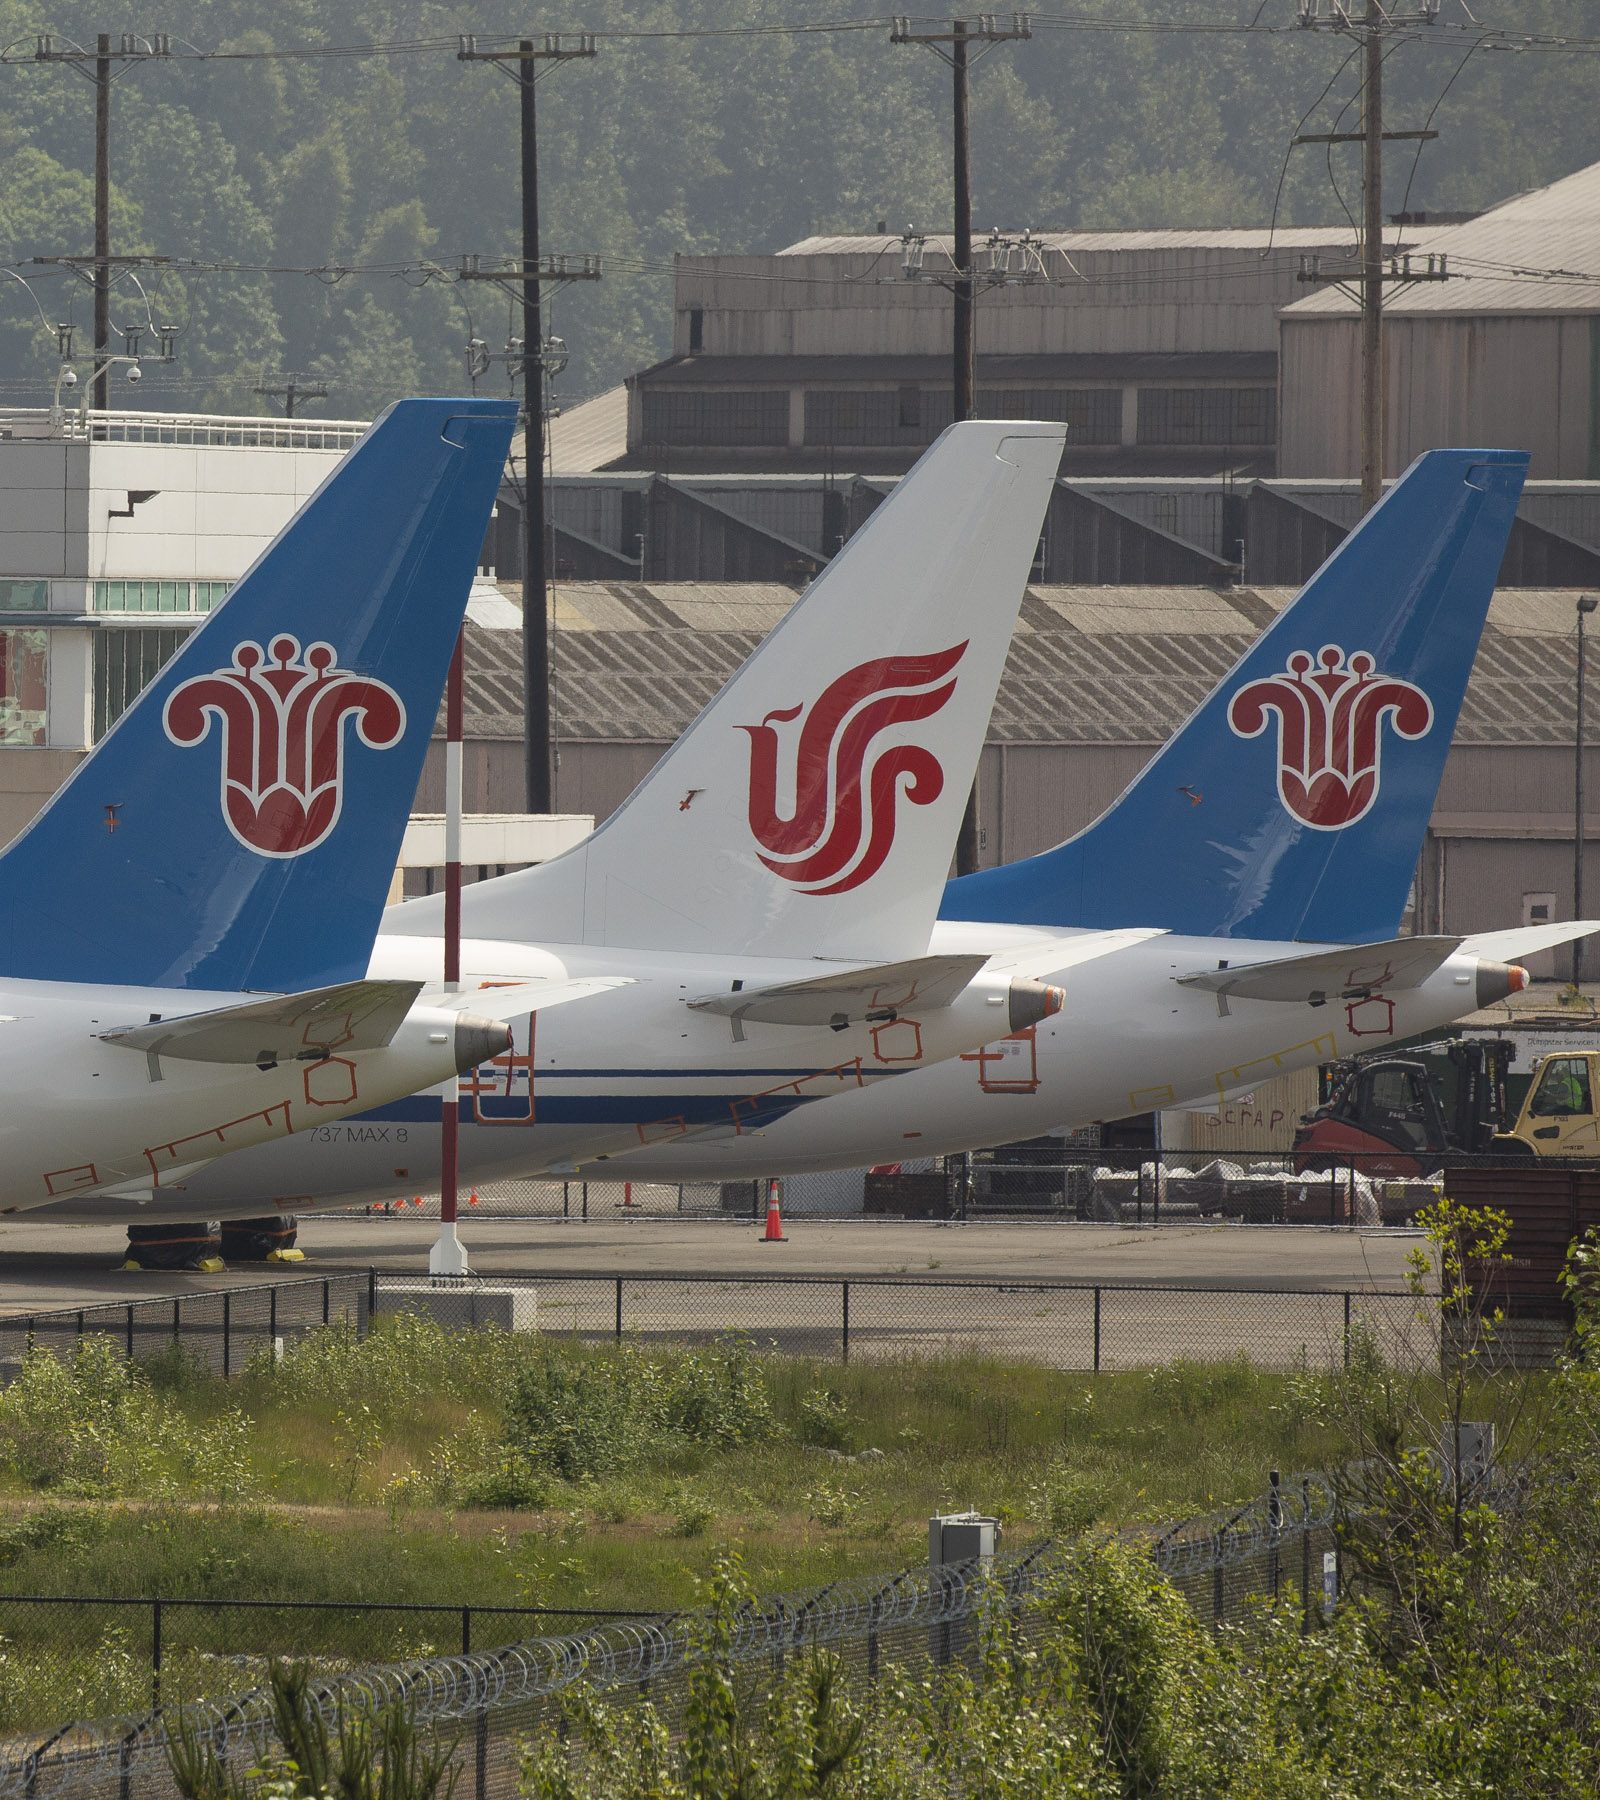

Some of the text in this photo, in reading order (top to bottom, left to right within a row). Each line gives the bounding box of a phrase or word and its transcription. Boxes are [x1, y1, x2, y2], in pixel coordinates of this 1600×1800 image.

[310, 1127, 408, 1143] 737 MAX 8
